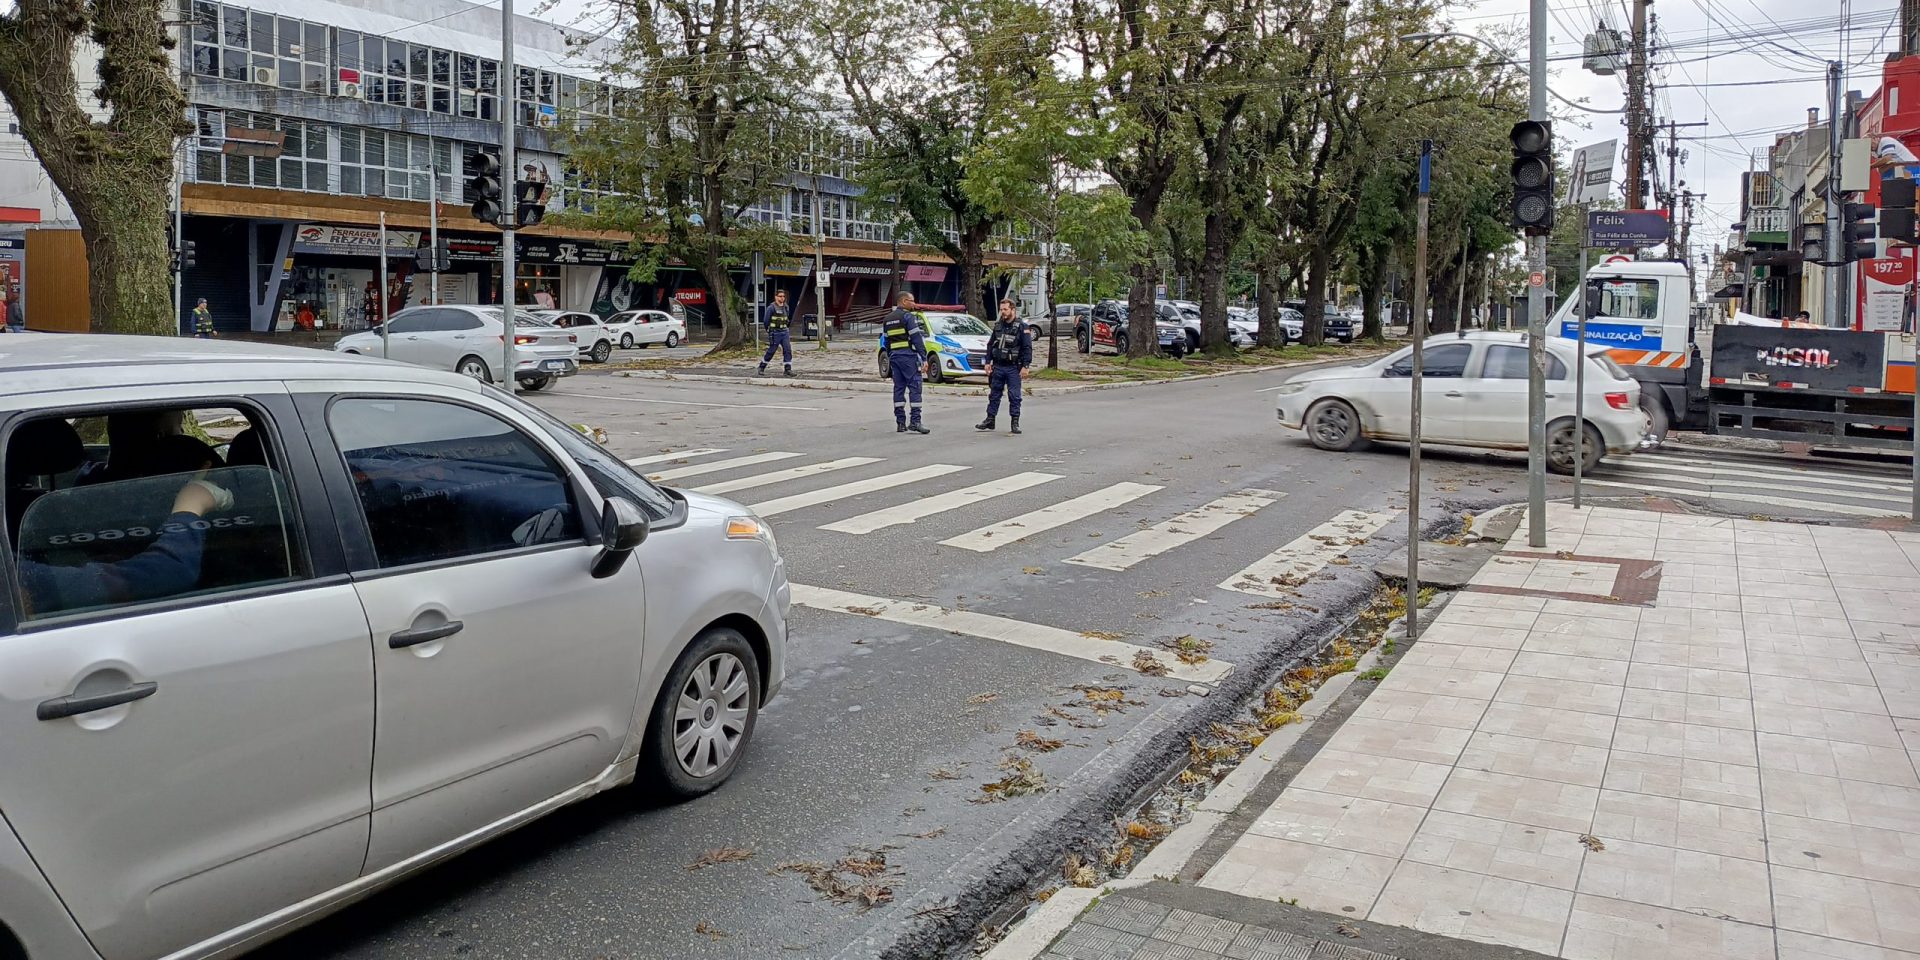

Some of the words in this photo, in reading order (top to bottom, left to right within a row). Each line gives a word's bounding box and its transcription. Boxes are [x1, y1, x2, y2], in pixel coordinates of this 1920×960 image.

[1596, 215, 1625, 225] Félix
[332, 229, 378, 238] FERRAGEM
[329, 236, 396, 246] REZENE
[835, 265, 848, 273] ART
[848, 266, 870, 274] COUROS
[875, 267, 892, 275] PELES
